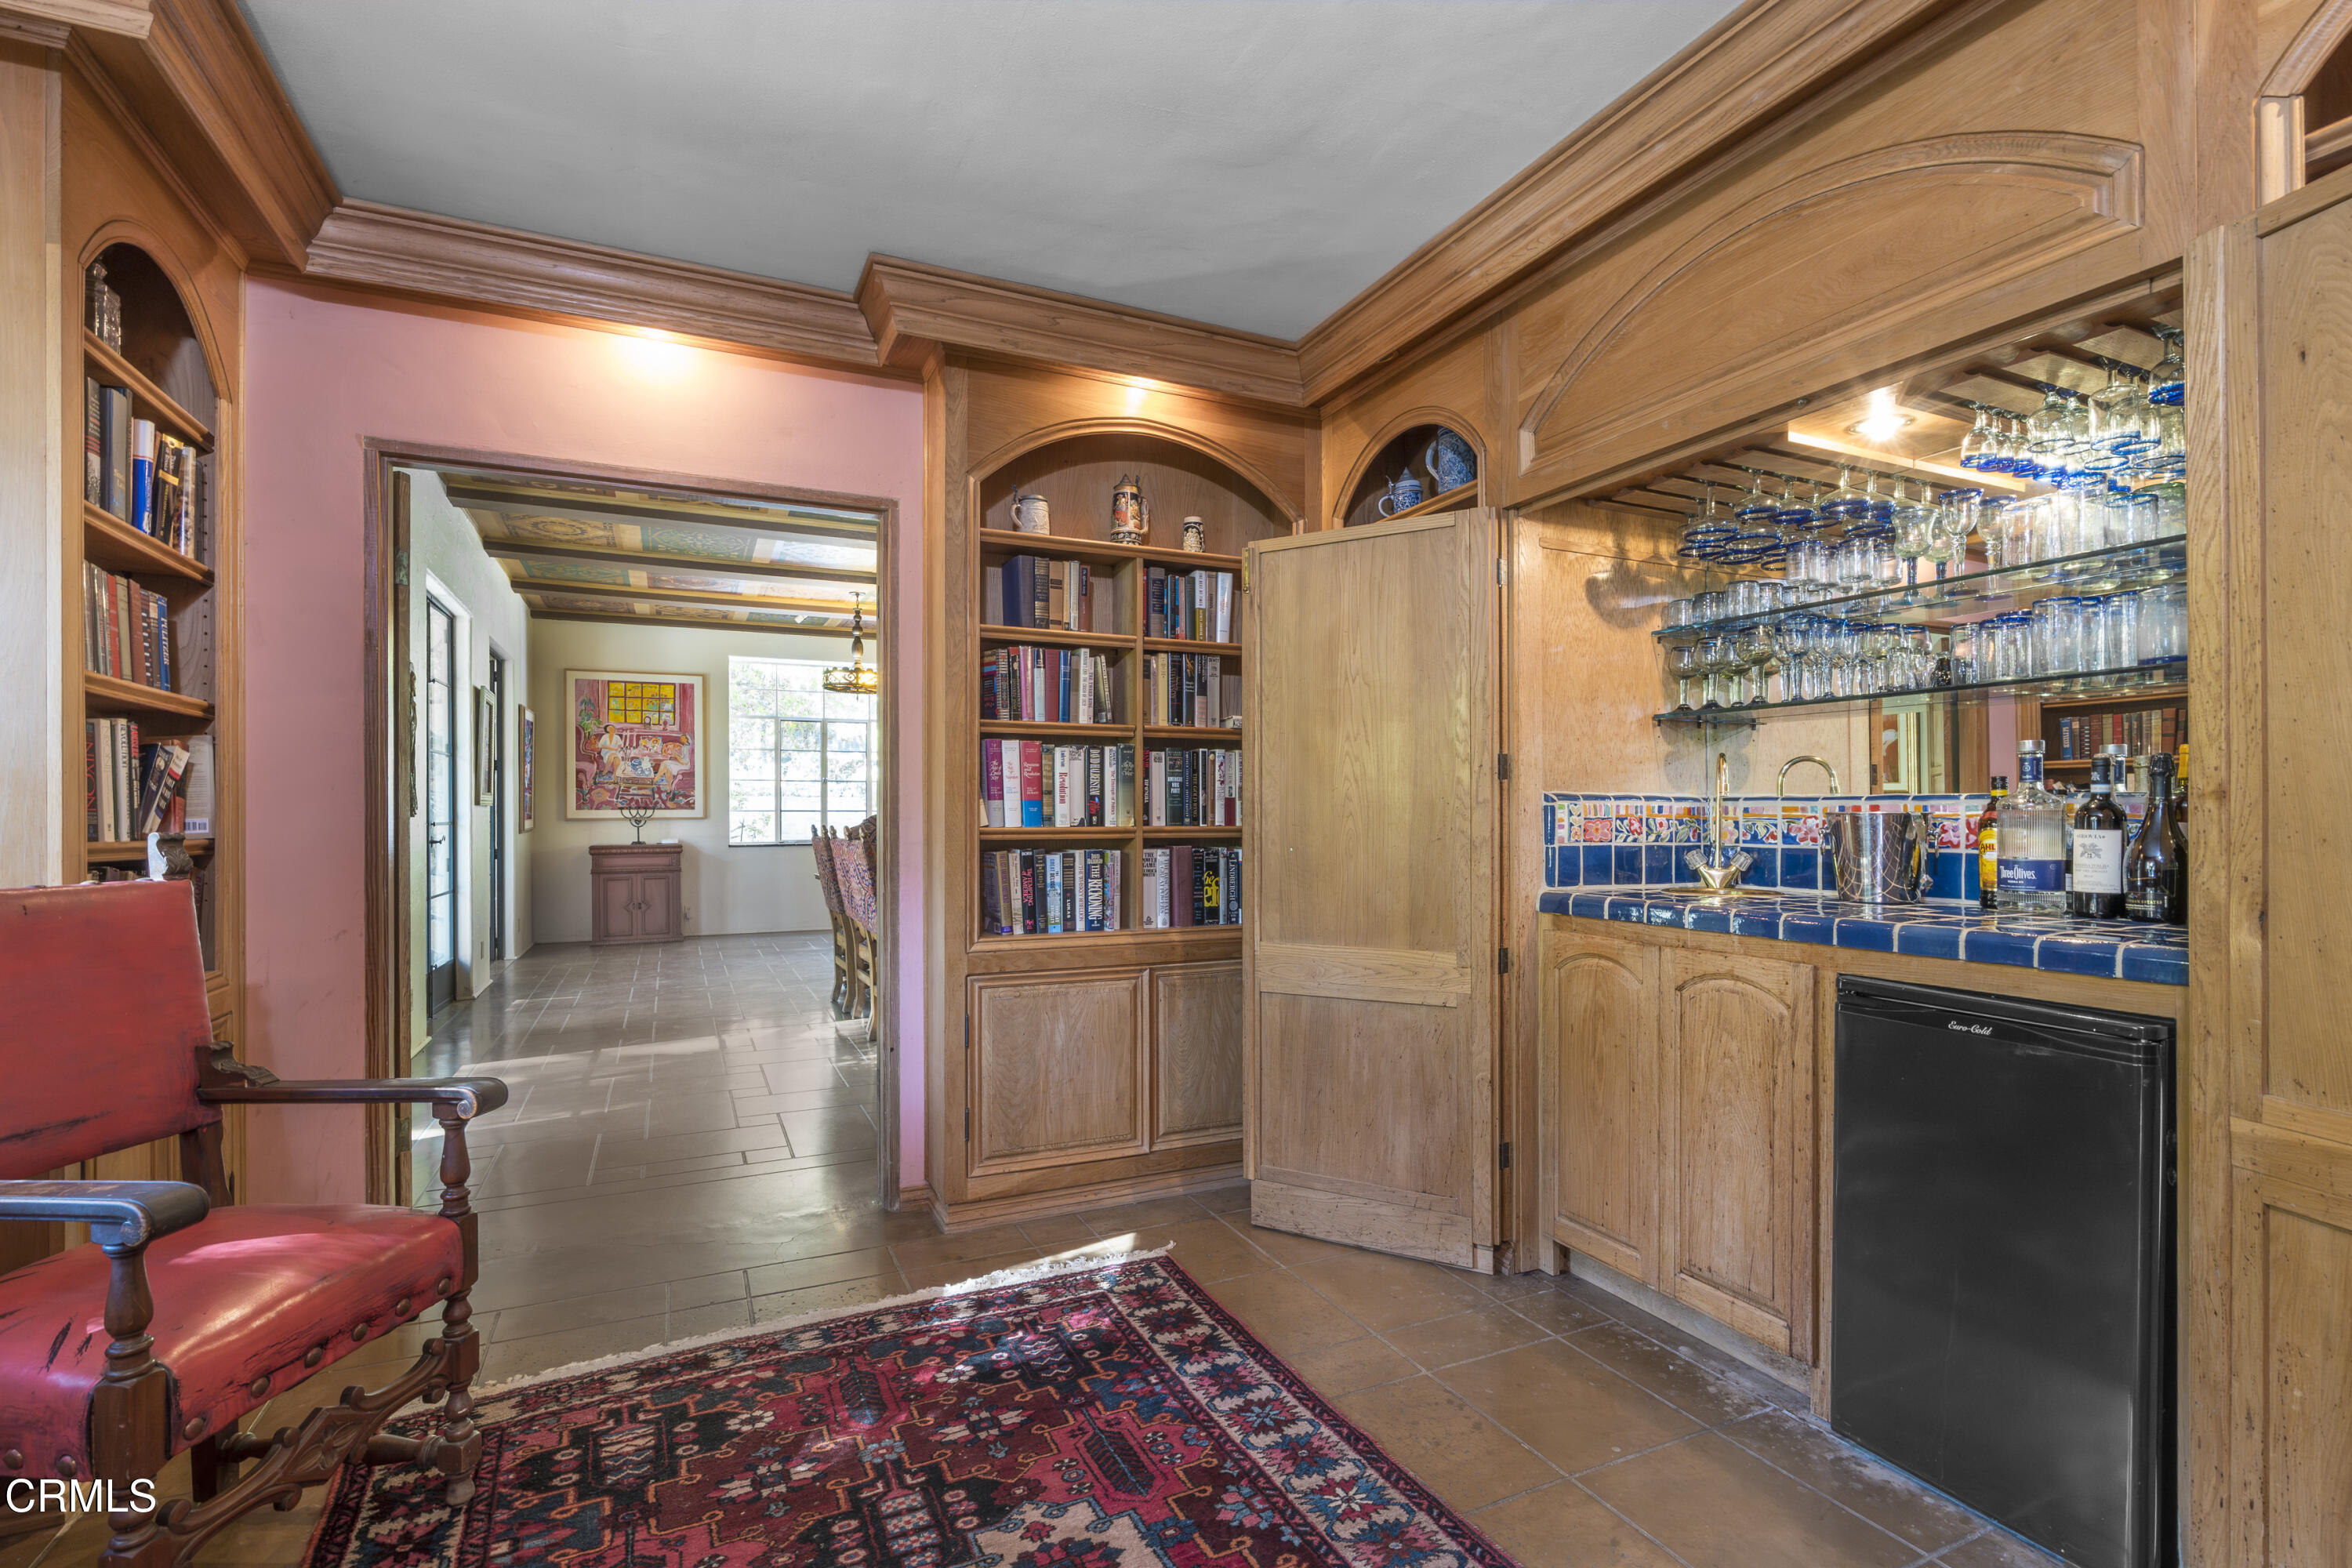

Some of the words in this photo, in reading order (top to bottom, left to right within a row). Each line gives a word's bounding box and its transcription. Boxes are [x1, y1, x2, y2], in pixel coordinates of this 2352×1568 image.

[161, 617, 170, 666] PULITZER
[1089, 750, 1101, 764] DAVID
[86, 741, 96, 812] NIXON
[1058, 772, 1069, 804] Revolution
[1089, 764, 1101, 795] HALBERSTAM
[1979, 840, 1996, 854] KAHL
[1091, 864, 1100, 878] THE
[1999, 866, 2014, 879] Three
[1088, 878, 1103, 920] RECKONING
[1947, 1020, 1993, 1036] Euro-Gold
